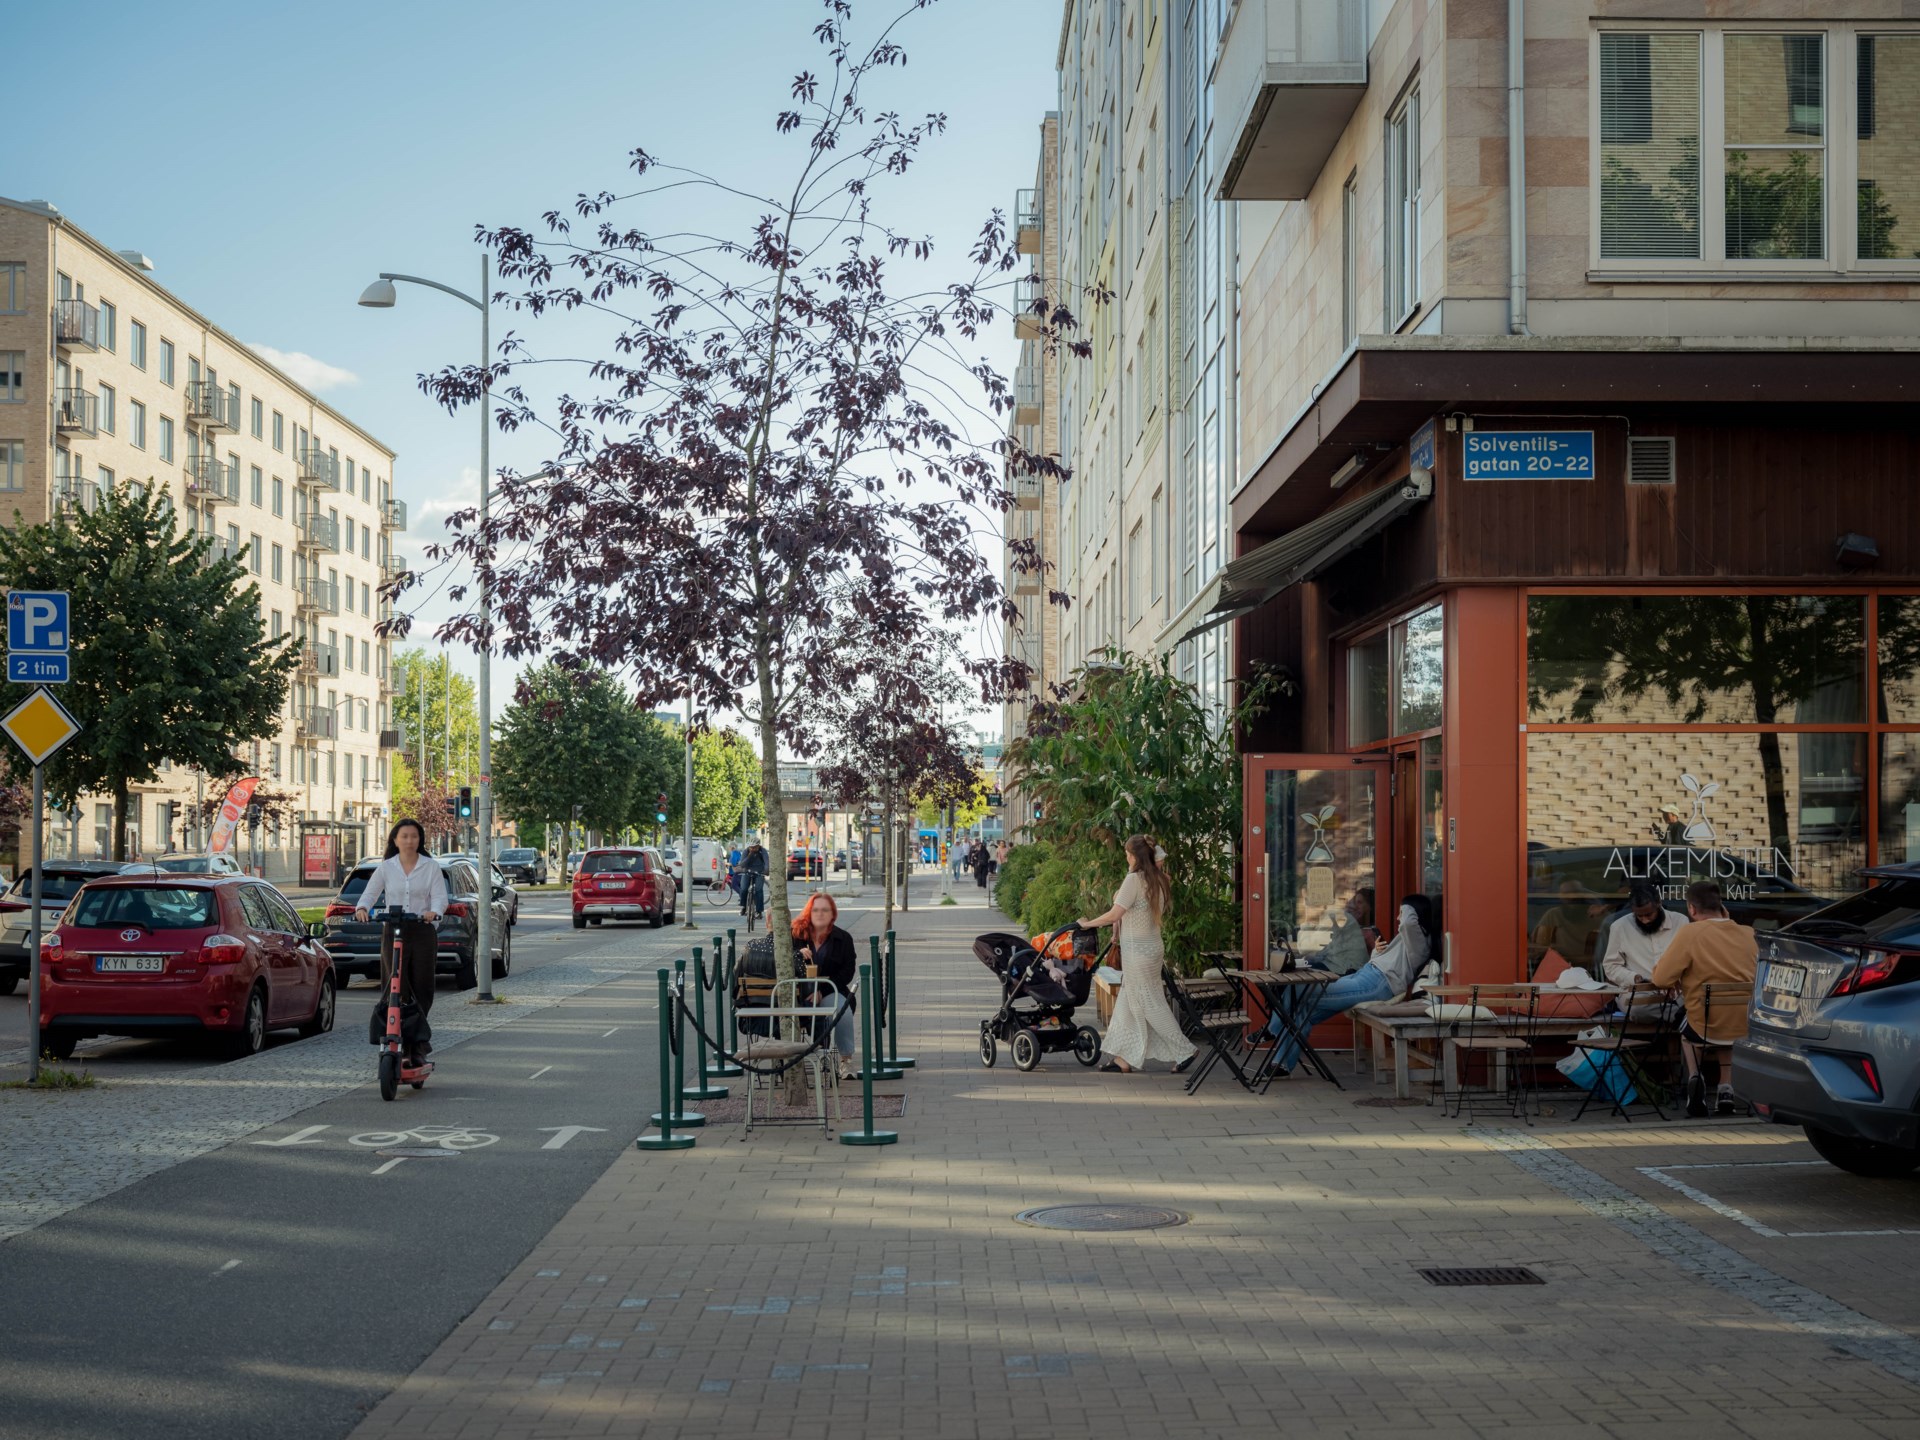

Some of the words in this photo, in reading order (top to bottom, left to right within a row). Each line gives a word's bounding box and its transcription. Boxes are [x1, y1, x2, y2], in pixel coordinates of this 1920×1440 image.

[1468, 437, 1569, 452] Solventils-
[1468, 457, 1520, 475] gatan
[1527, 456, 1590, 471] 20-22
[25, 598, 58, 645] P
[17, 661, 28, 675] 2
[34, 661, 60, 675] tim
[1603, 847, 1799, 878] ALKEMISTEN
[104, 958, 128, 970] KYN
[136, 958, 160, 970] 633
